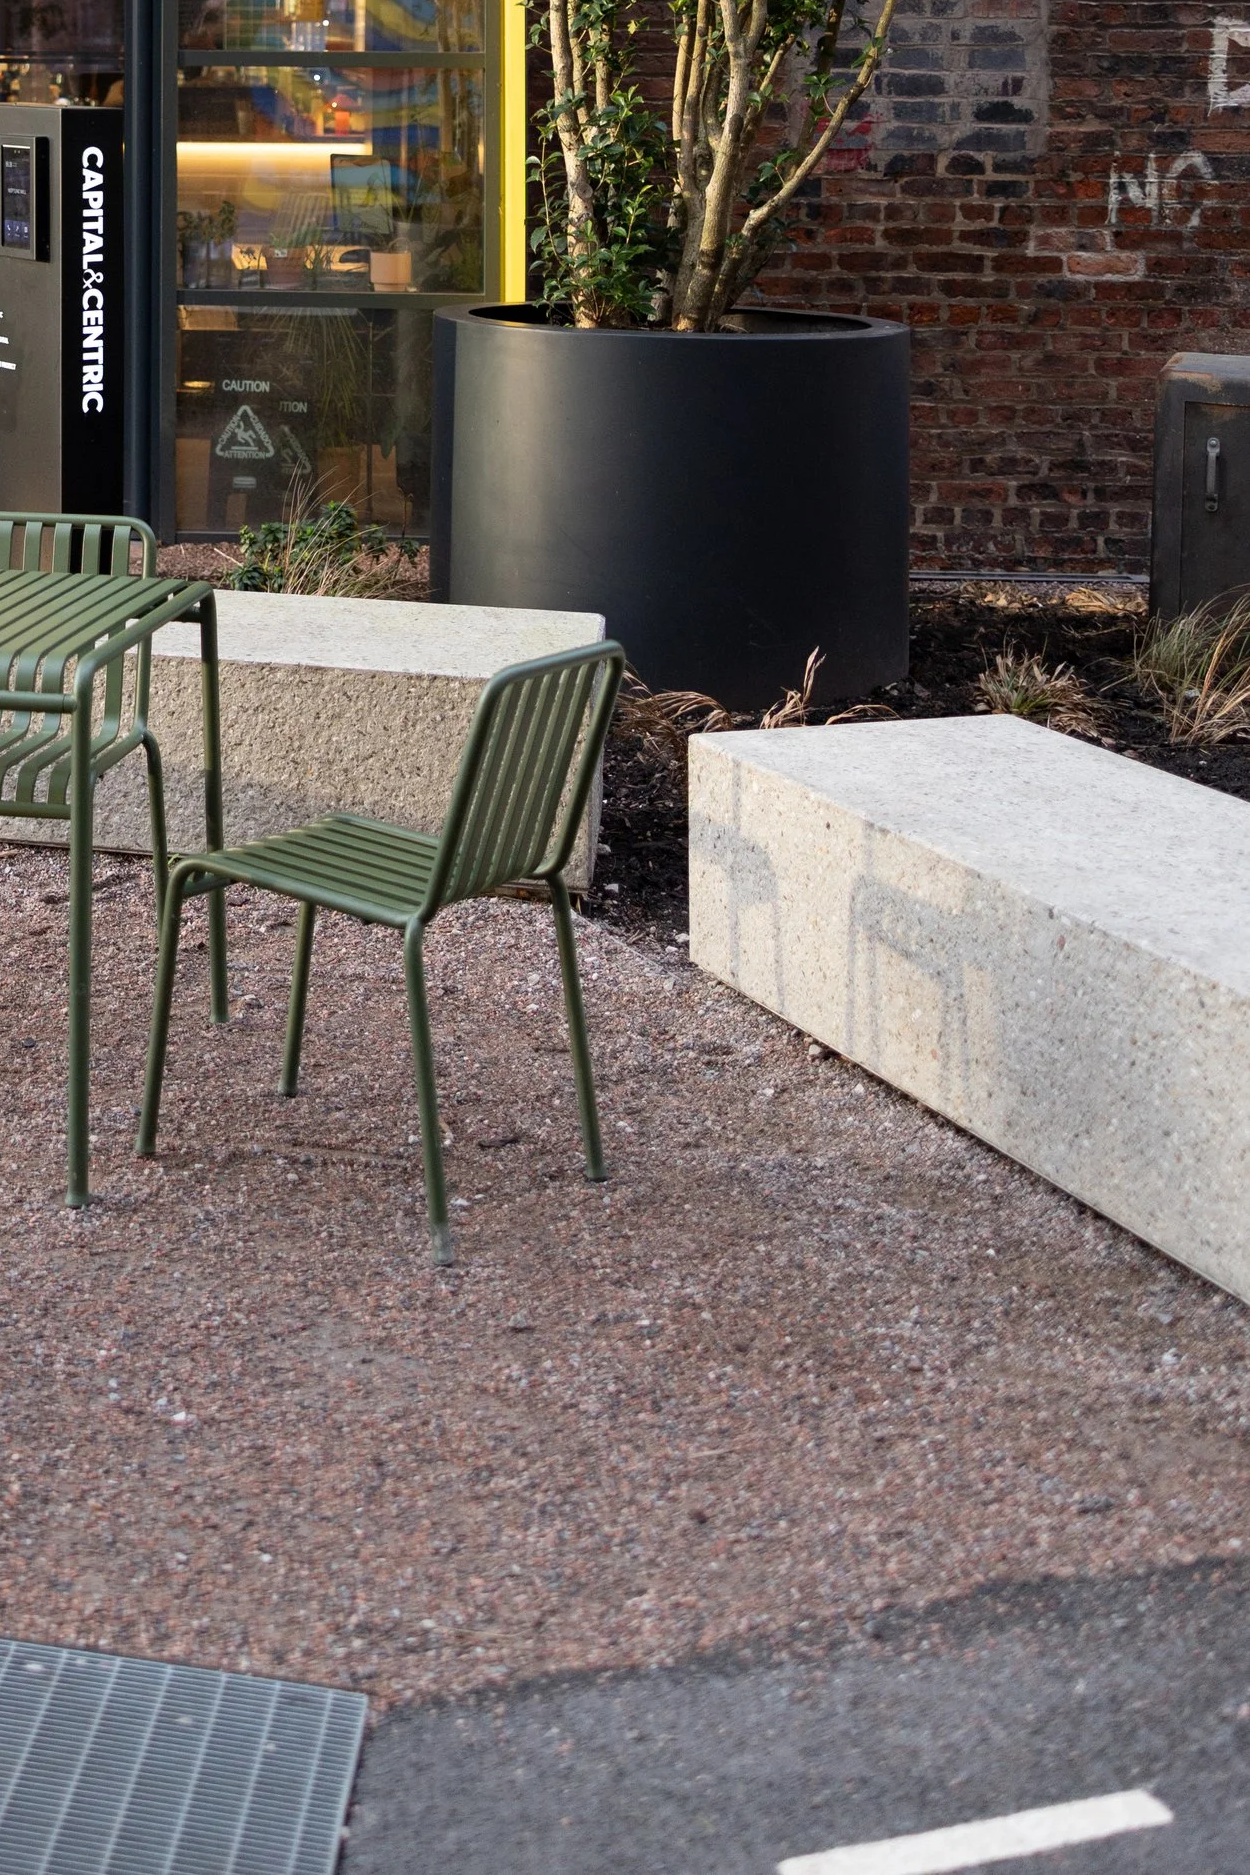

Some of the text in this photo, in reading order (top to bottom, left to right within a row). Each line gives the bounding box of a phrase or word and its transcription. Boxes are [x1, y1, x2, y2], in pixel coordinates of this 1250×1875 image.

[81, 145, 105, 415] CAPITAL&CENTRIC
[221, 379, 271, 393] CAUTION
[217, 414, 242, 445] CAUTION
[223, 450, 266, 460] ATTENTION
